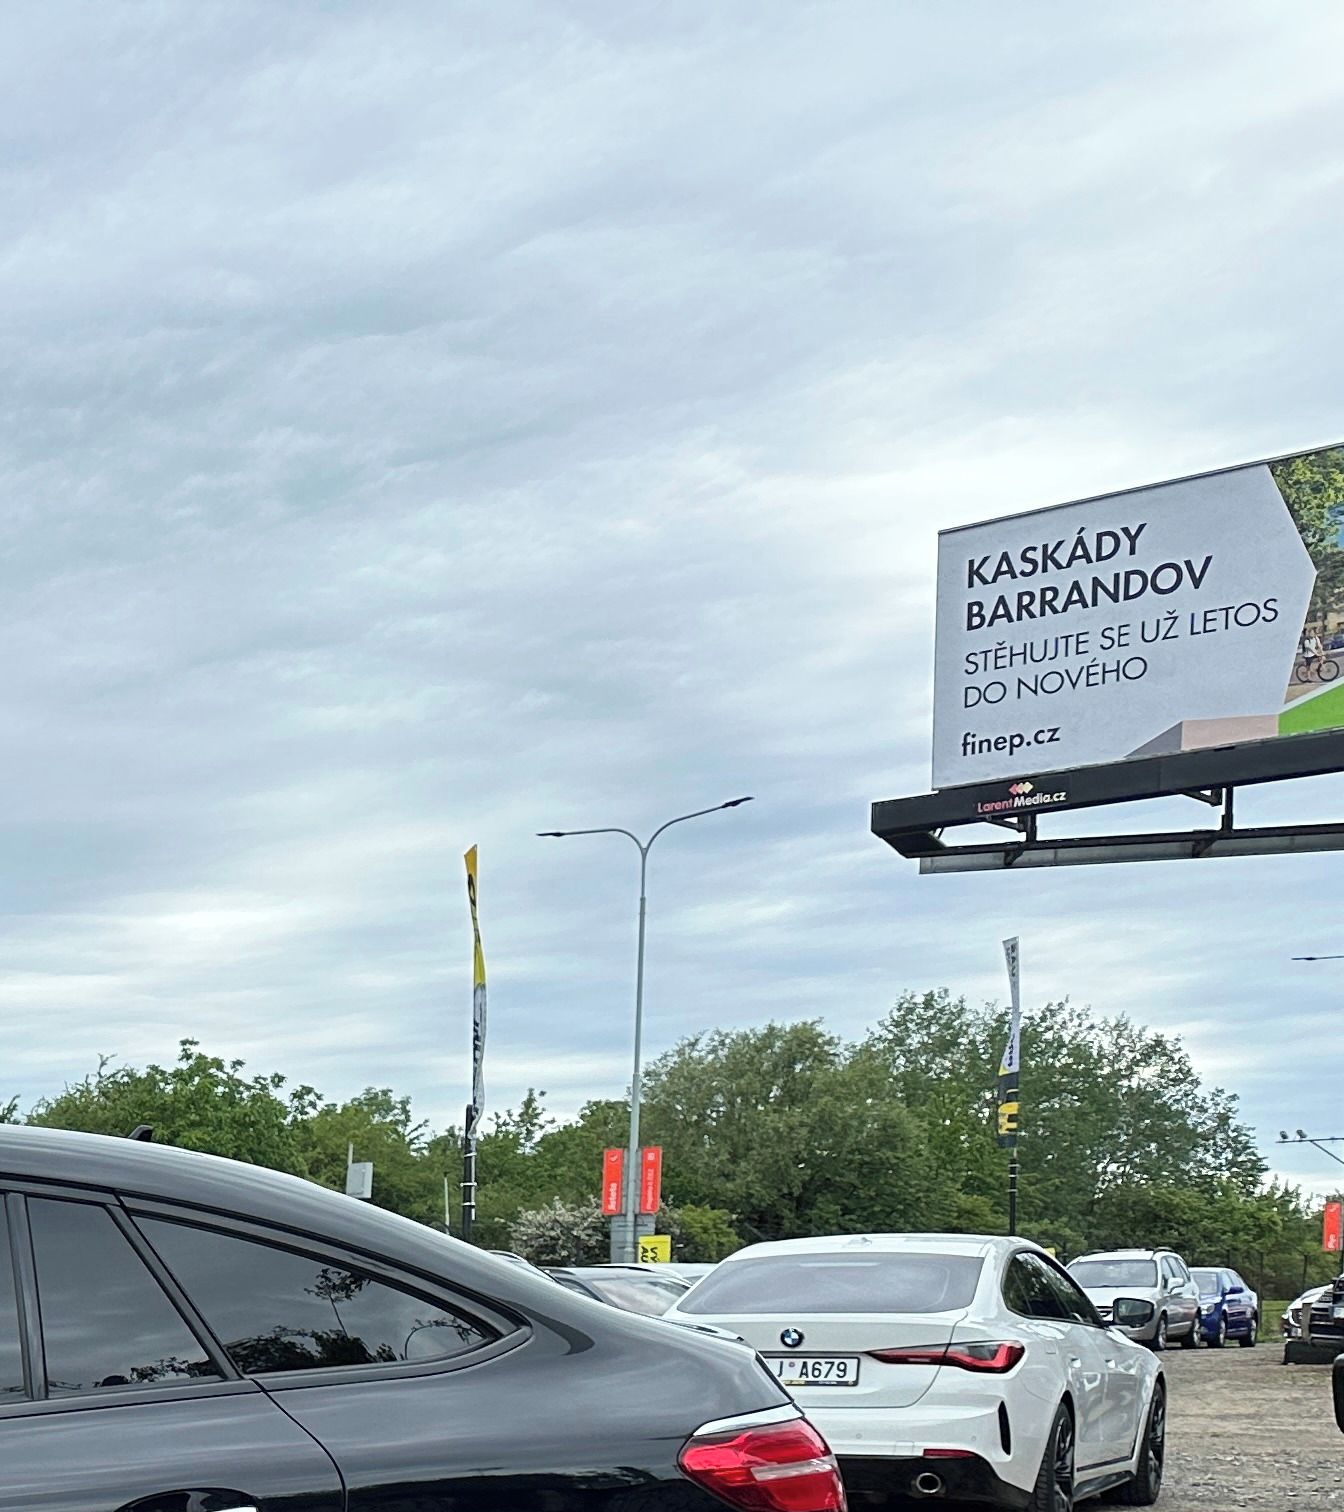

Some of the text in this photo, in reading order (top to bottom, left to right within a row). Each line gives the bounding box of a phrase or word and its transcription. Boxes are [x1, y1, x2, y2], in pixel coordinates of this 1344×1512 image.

[967, 523, 1147, 588] KASKÁDY
[966, 556, 1212, 631] BARRANDOV
[964, 598, 1279, 675] STĚHUJTE SE UŽ LETOS
[964, 656, 1147, 708] DO NOVÉHO
[962, 726, 1061, 757] finep.cz
[977, 792, 1066, 813] LarentMedia.cz
[799, 1360, 848, 1379] A679
